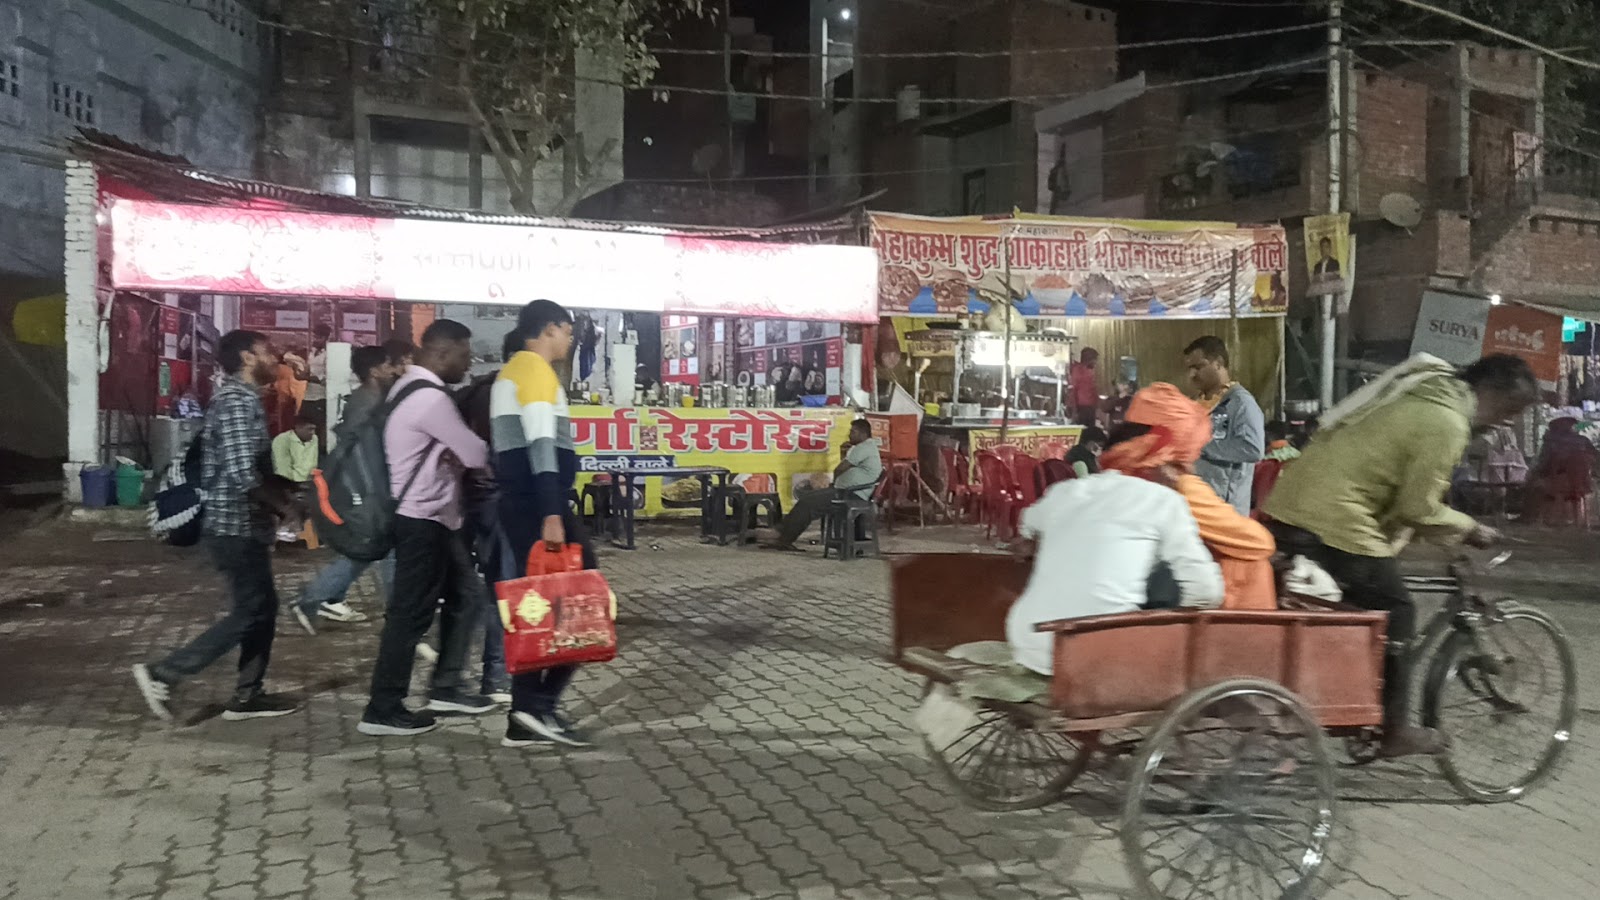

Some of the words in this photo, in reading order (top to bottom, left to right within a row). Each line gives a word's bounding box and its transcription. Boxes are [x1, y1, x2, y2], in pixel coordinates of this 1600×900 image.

[873, 229, 955, 276] महाकुम्भ
[960, 233, 1000, 278] शुद्ध
[1006, 230, 1089, 269] शाकाहारी
[1251, 233, 1285, 270] वाले
[1429, 320, 1478, 340] SURYA
[649, 409, 832, 451] रेस्टोरेंट
[579, 456, 630, 471] दिल्ली
